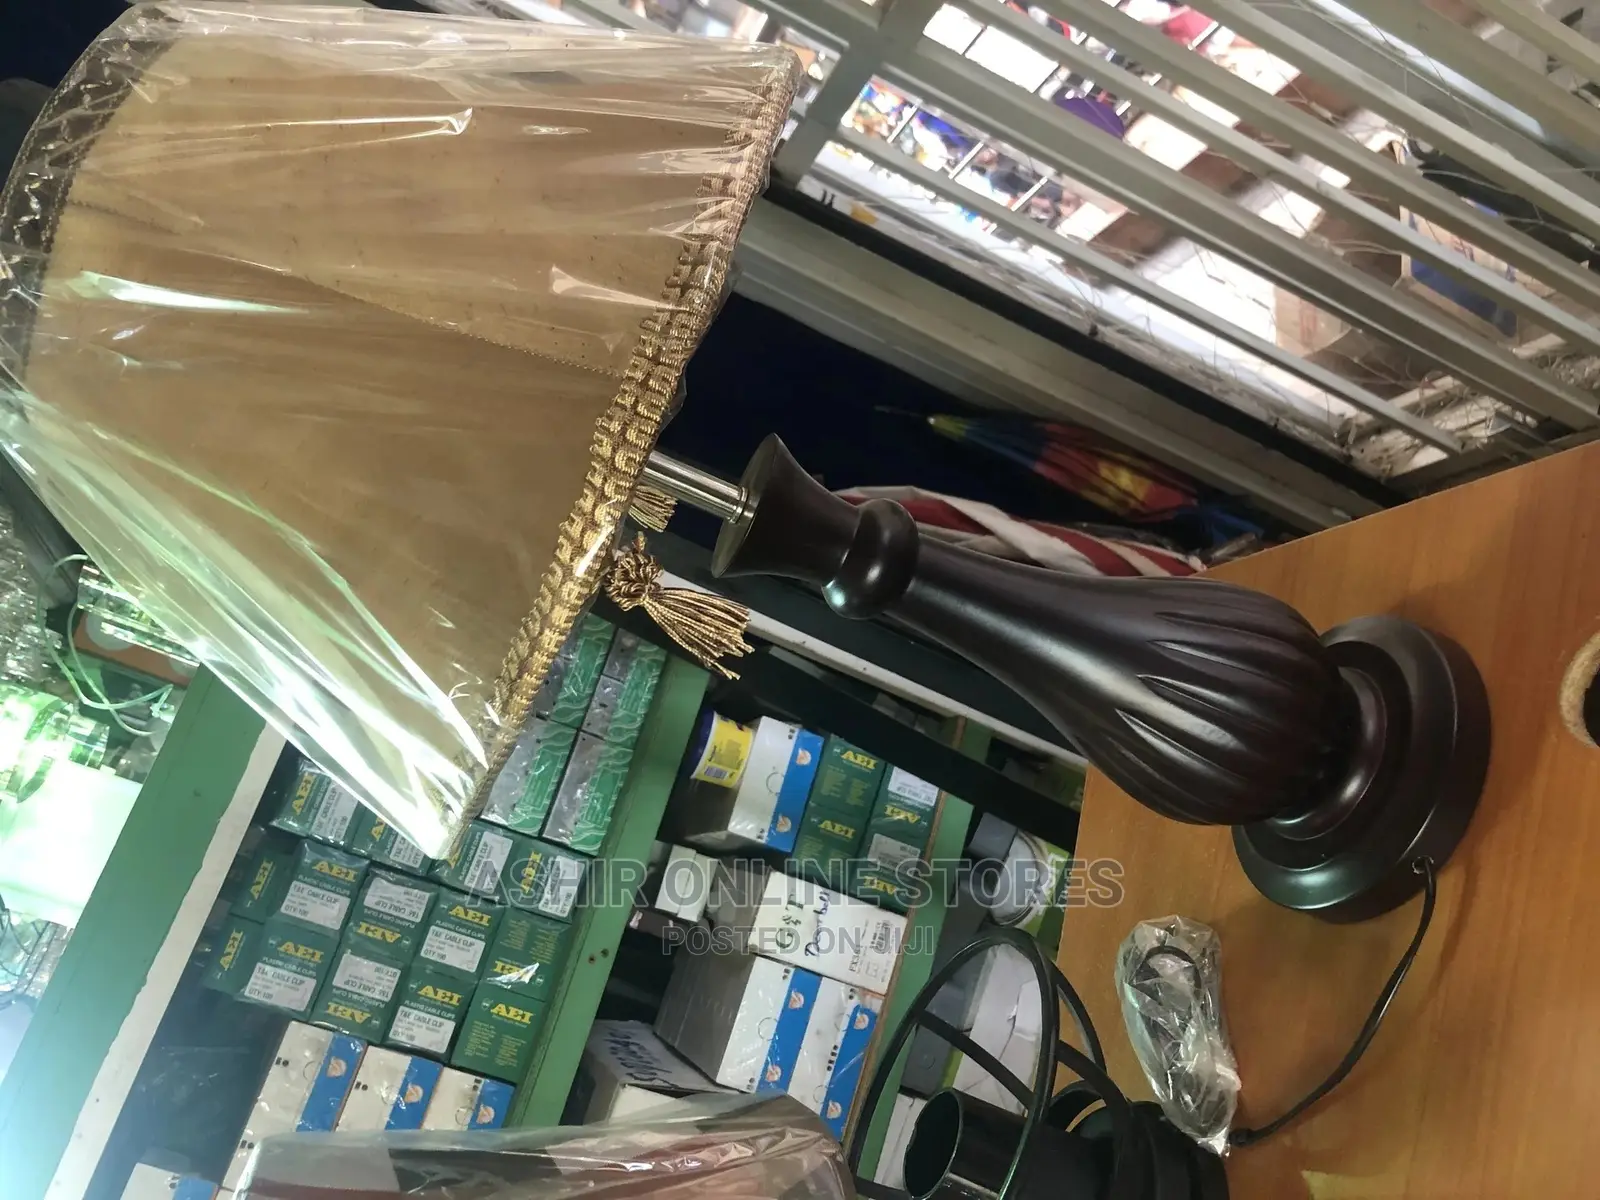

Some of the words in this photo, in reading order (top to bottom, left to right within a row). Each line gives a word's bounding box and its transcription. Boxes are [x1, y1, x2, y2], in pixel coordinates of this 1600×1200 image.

[842, 750, 877, 770] AEI
[292, 772, 315, 815] AEI
[819, 820, 856, 838] AEI
[250, 859, 274, 900] AEI
[312, 861, 357, 882] AEI
[448, 904, 492, 926] AEI
[357, 921, 401, 943] AEI
[220, 928, 243, 971] AEI
[277, 942, 324, 963] AEI
[418, 985, 463, 1006] AEI
[326, 1002, 371, 1024] AEI
[490, 1004, 535, 1024] AEI
